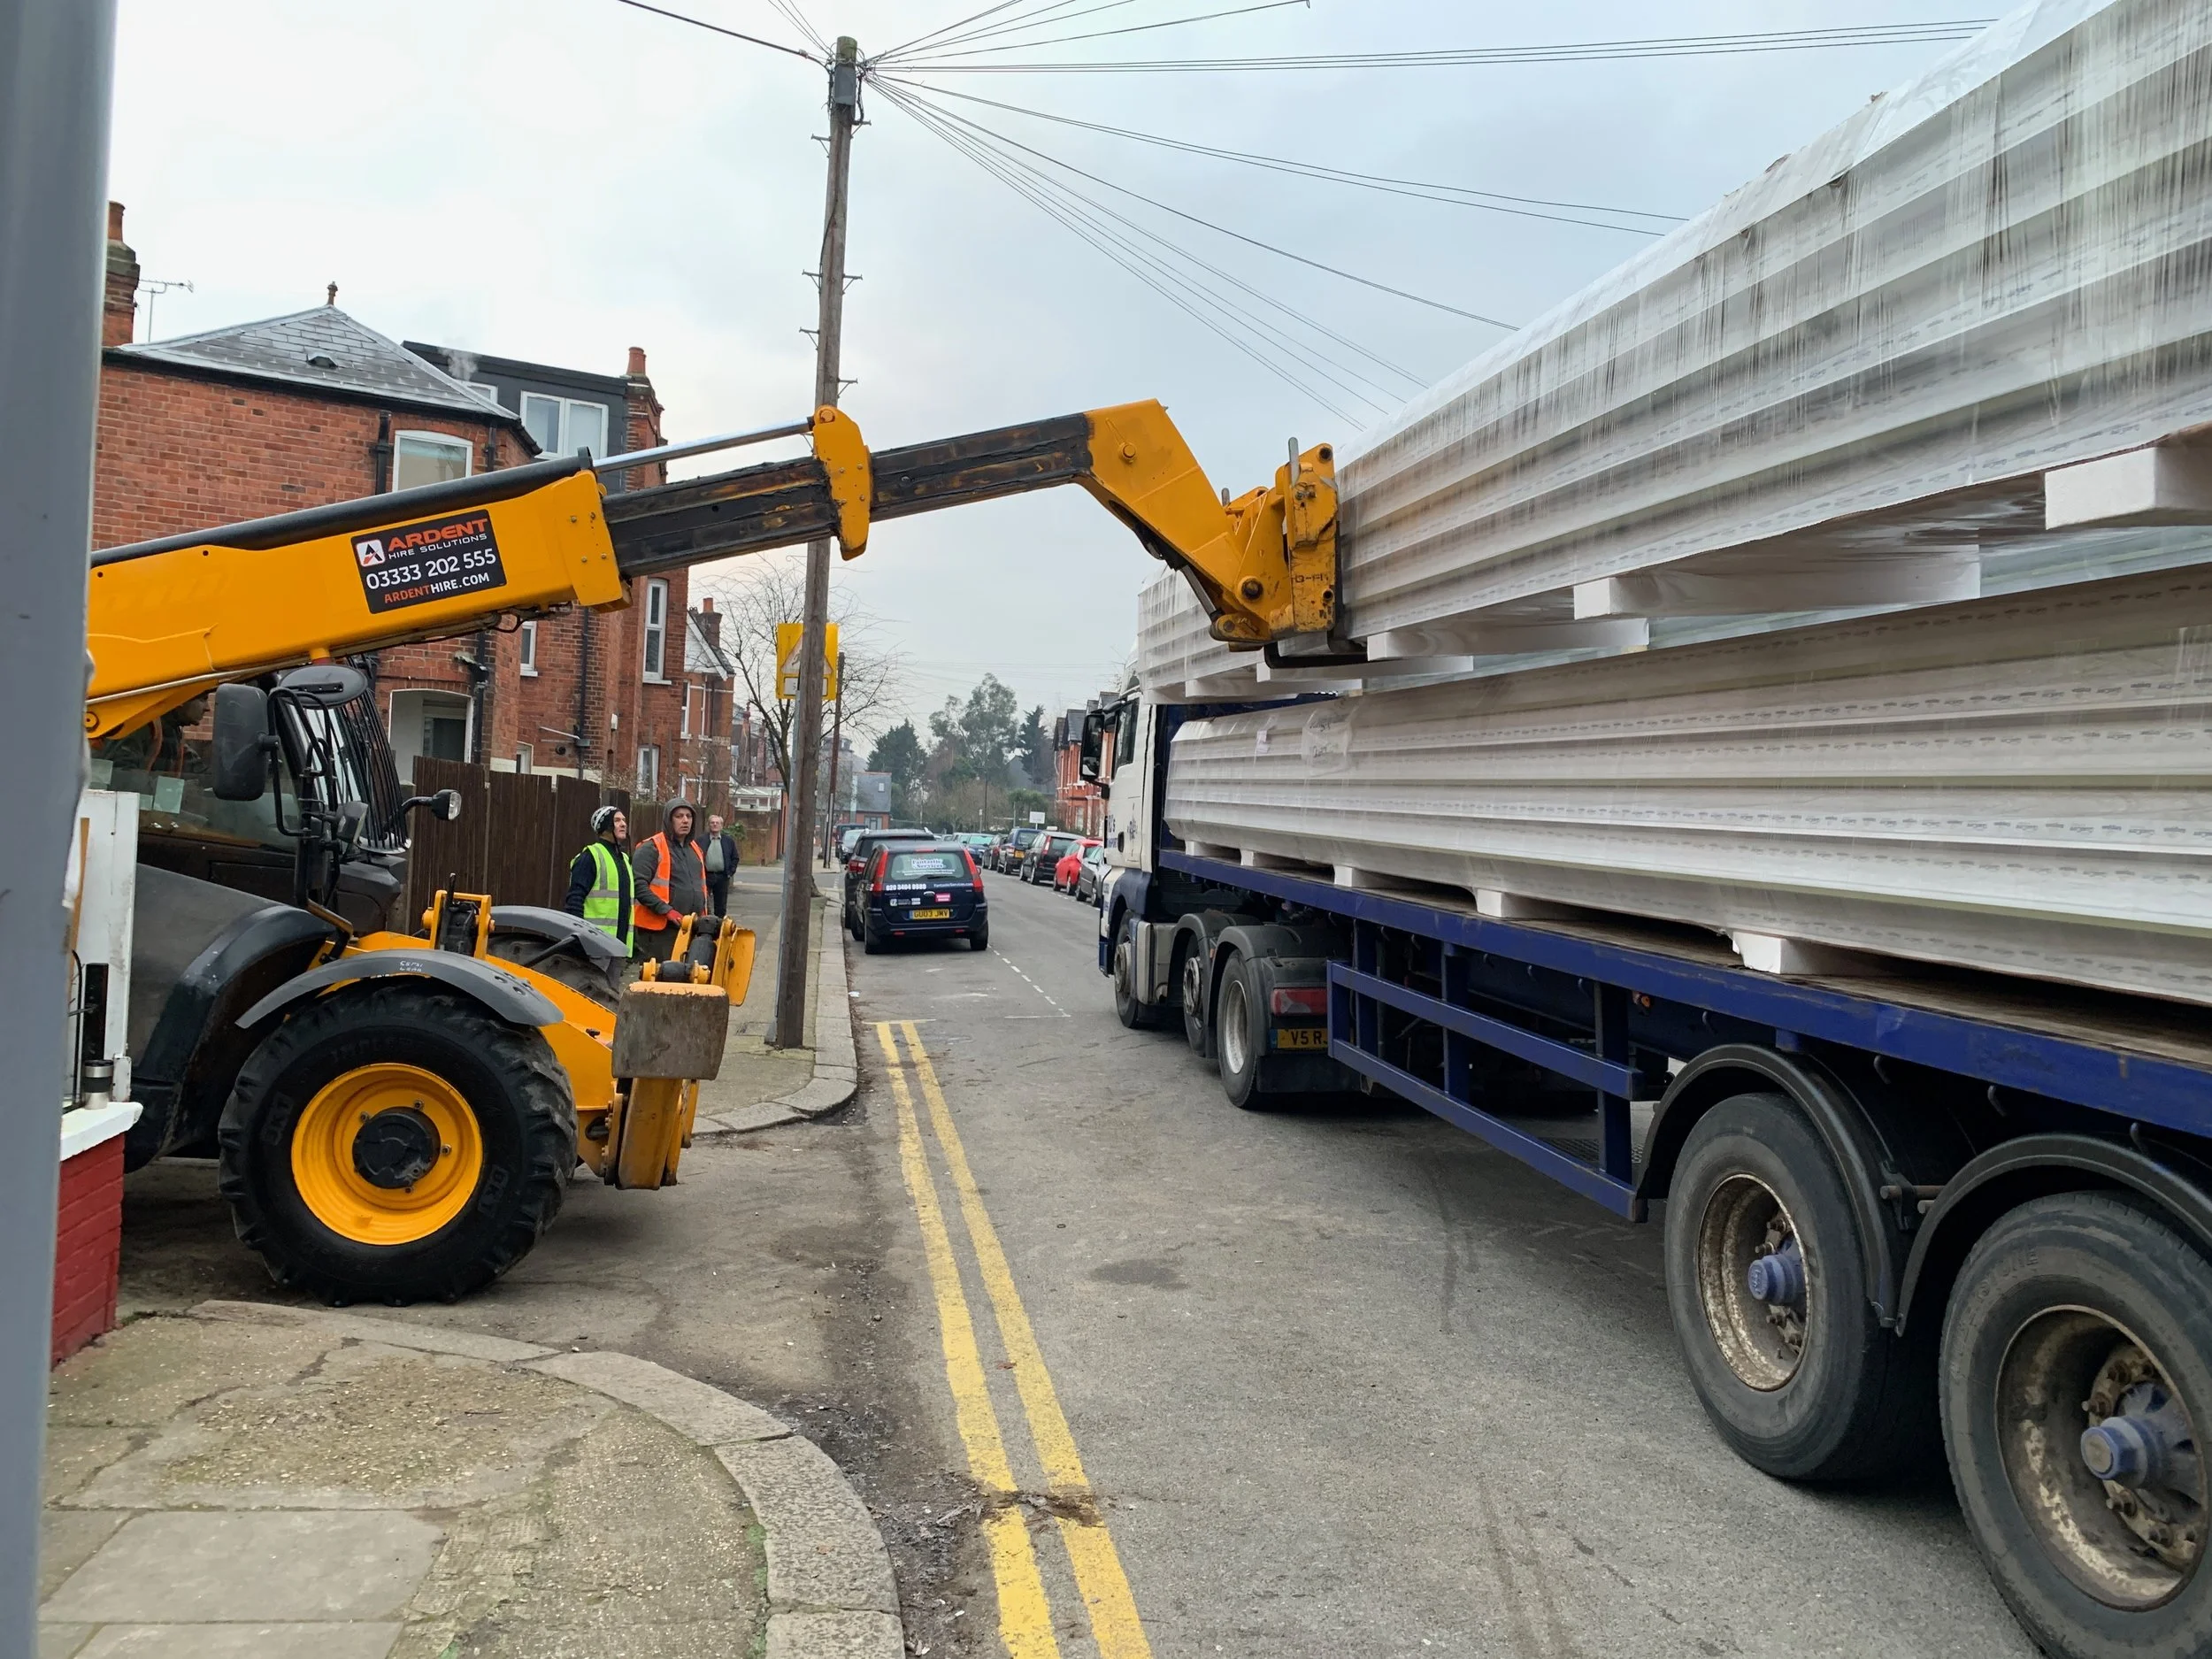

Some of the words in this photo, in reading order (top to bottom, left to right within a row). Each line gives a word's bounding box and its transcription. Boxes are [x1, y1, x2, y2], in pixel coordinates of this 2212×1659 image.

[388, 518, 488, 551] ARDENT
[388, 548, 415, 560] HIRE
[419, 533, 488, 554] SOLUTIONS
[365, 564, 422, 590] 03333
[425, 556, 460, 578] 202
[463, 548, 496, 570] 555
[384, 572, 490, 604] ARDENTHIRE.COM
[1290, 1031, 1310, 1045] V5
[1313, 1031, 1328, 1045] R
